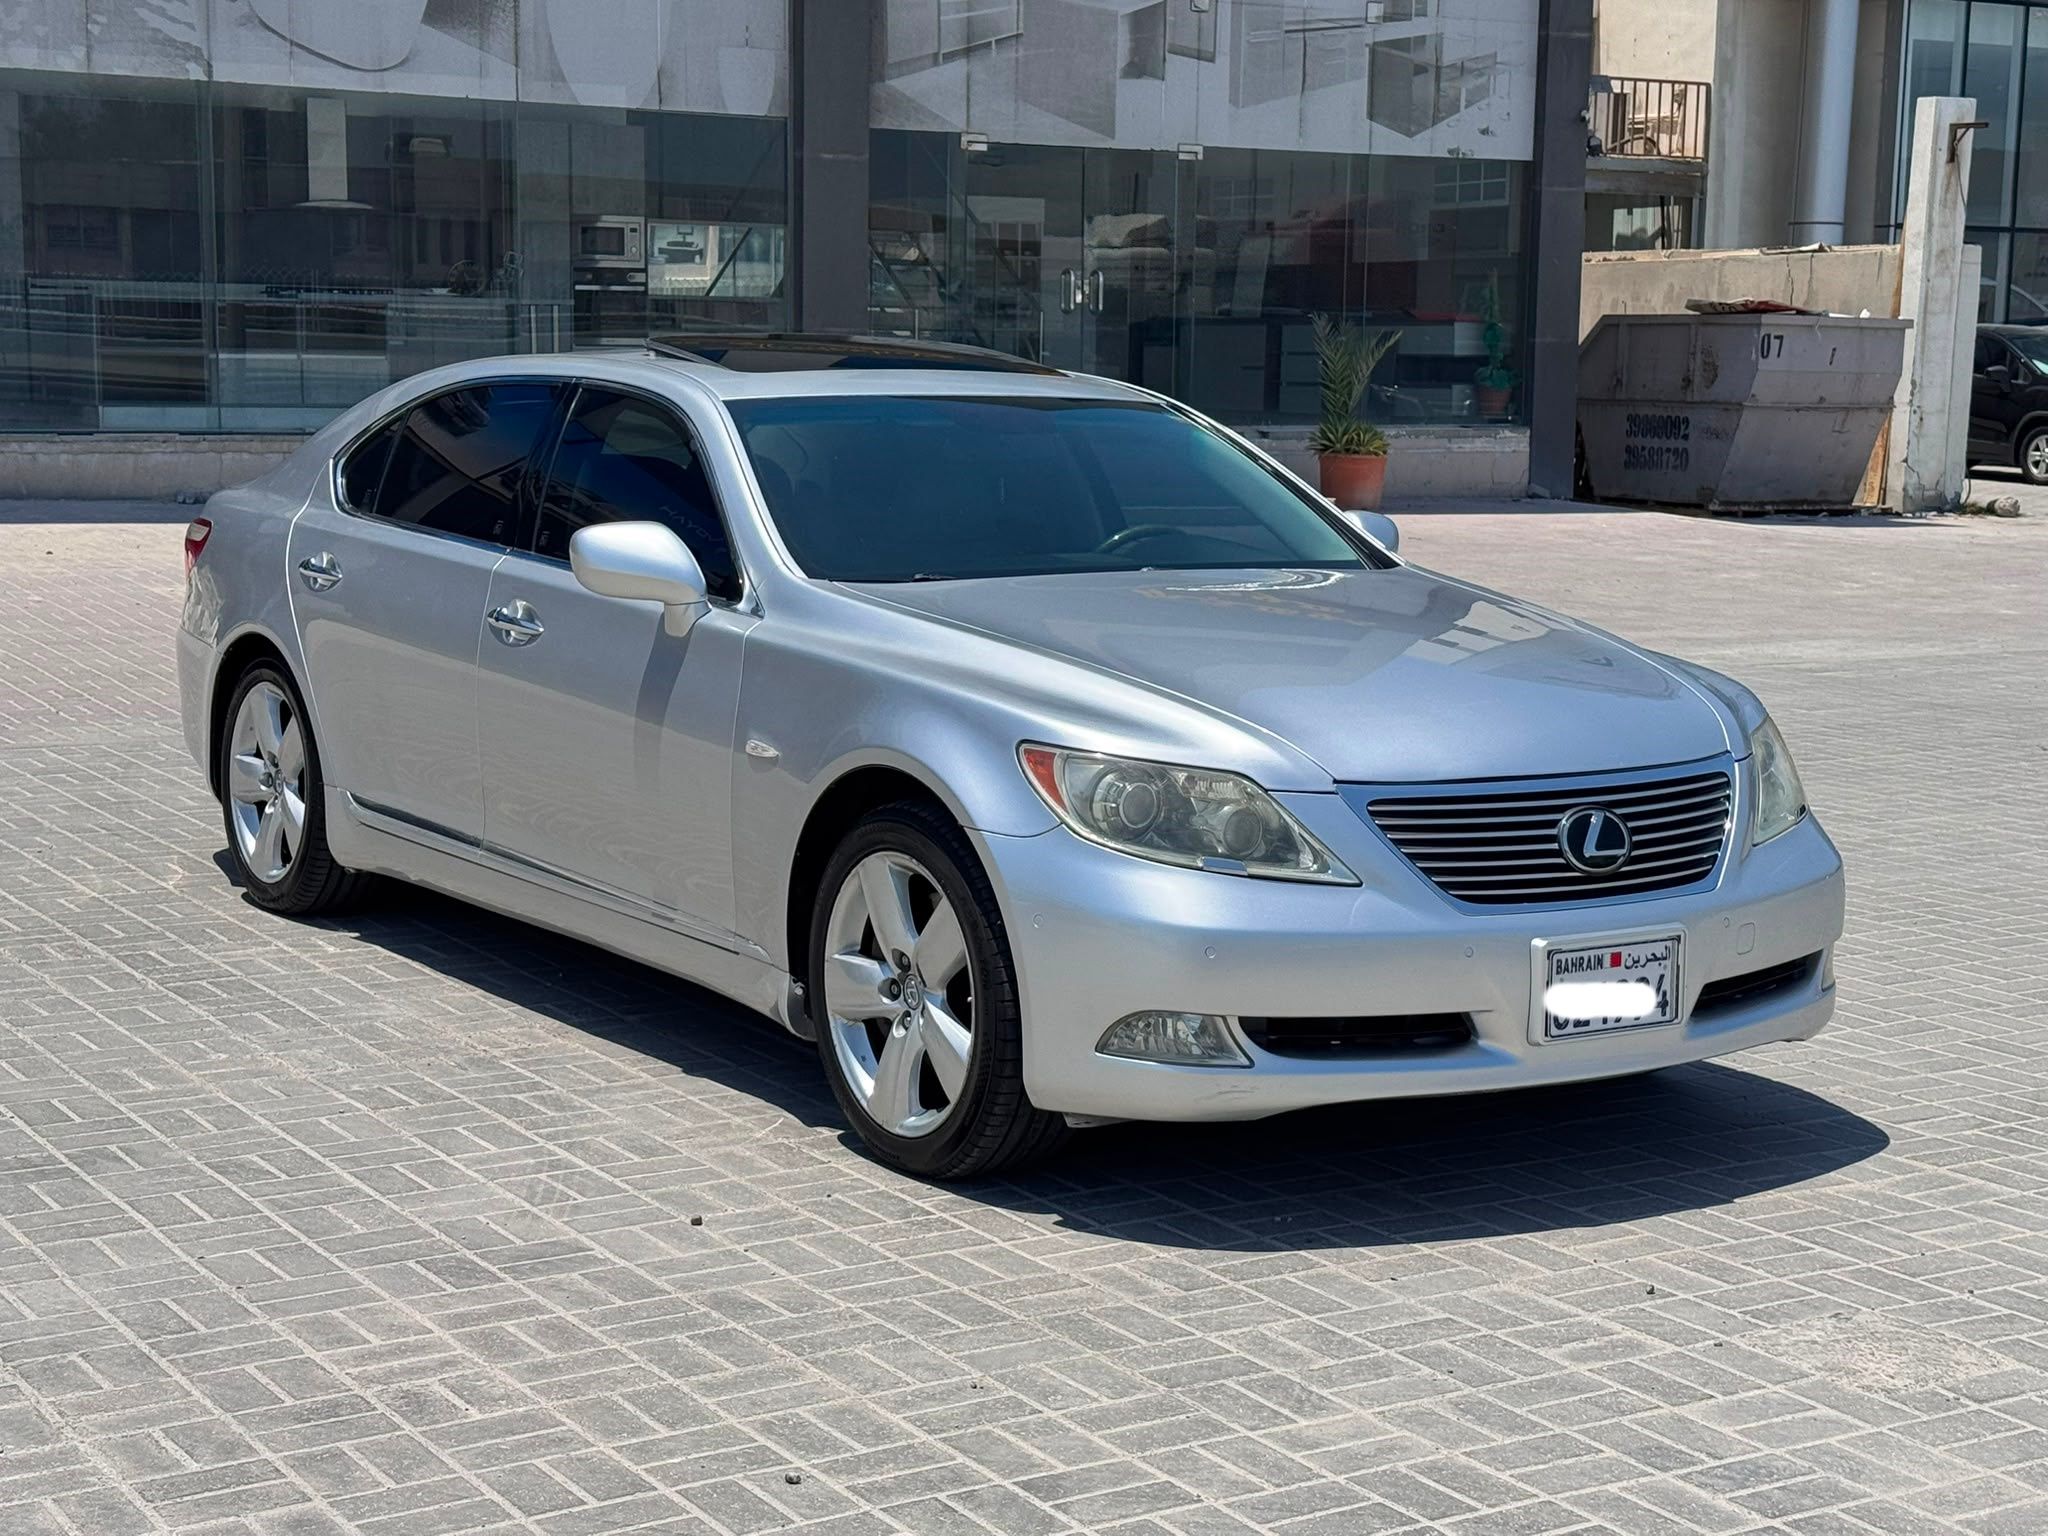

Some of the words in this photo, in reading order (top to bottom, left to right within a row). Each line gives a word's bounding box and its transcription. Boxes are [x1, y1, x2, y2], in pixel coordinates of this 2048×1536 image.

[1761, 333, 1784, 359] 07
[1556, 953, 1603, 975] BAHRAIN
[1624, 945, 1671, 969] البحرين
